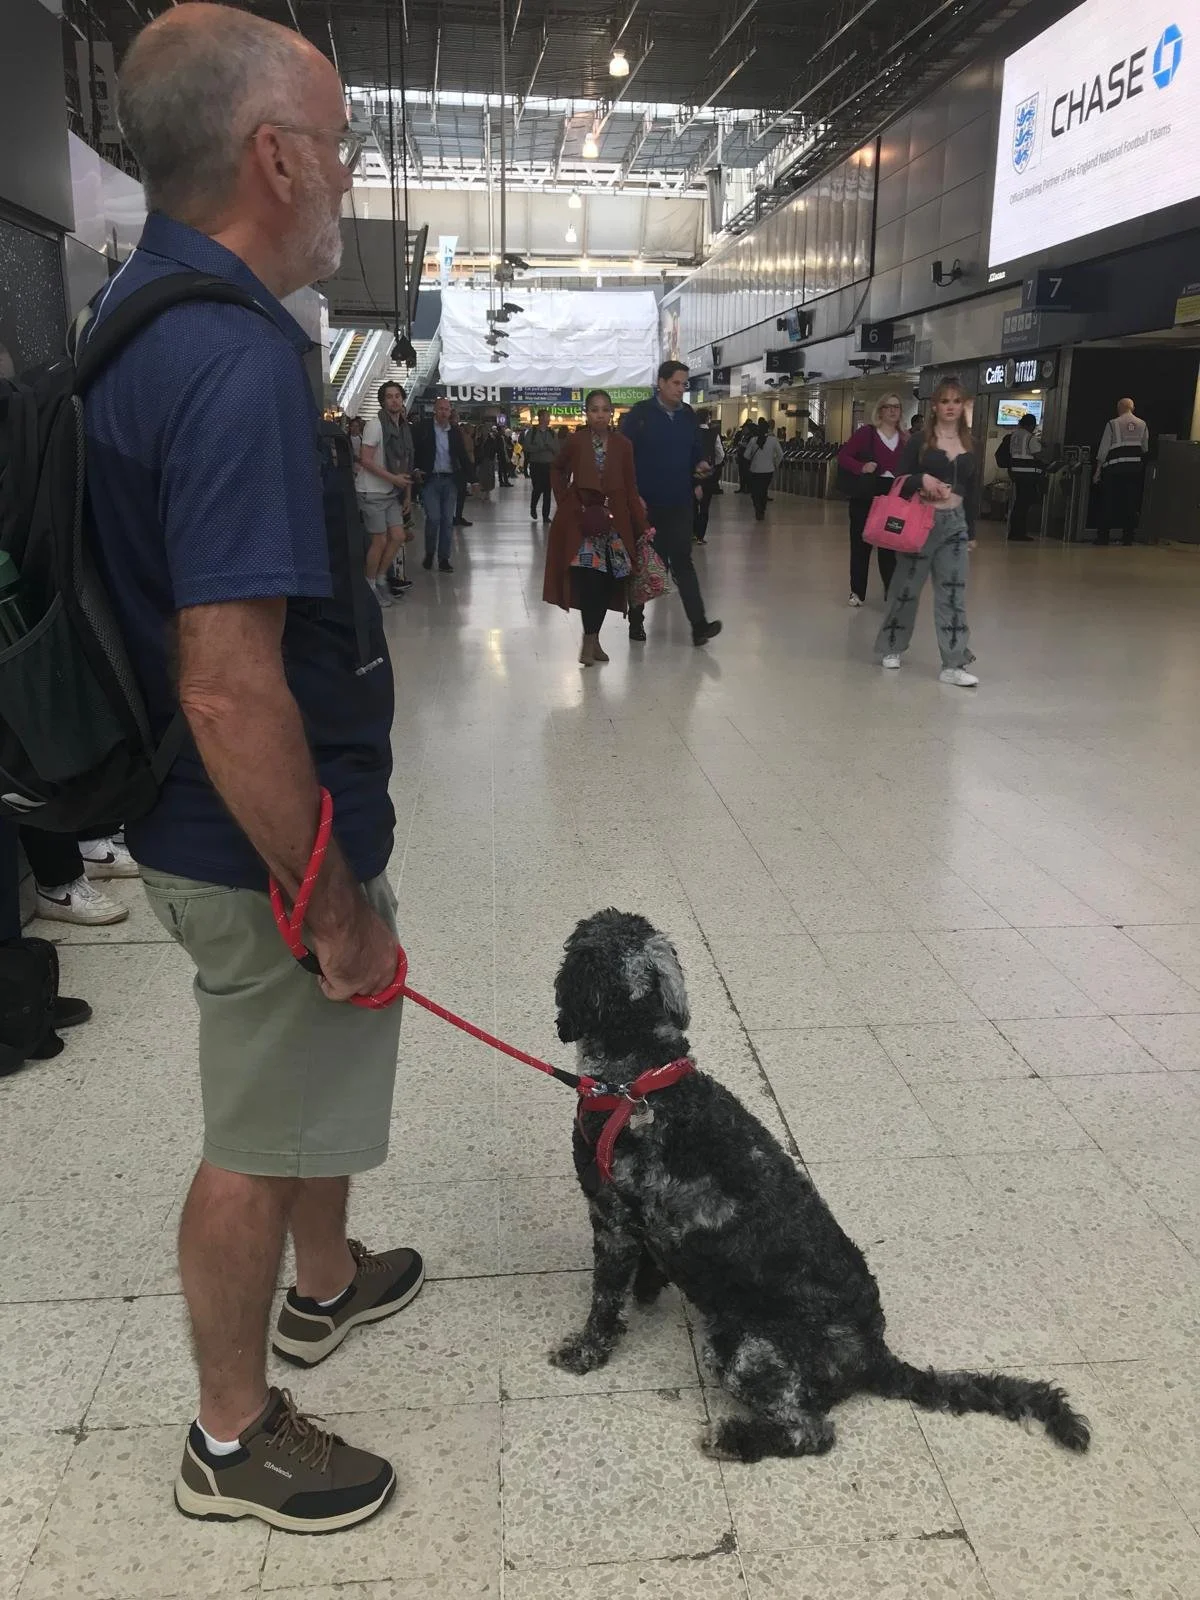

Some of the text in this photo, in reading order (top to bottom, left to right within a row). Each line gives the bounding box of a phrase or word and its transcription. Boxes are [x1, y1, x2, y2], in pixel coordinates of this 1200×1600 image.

[1051, 46, 1148, 138] CHASE
[1067, 166, 1077, 179] the
[1077, 154, 1099, 176] England
[1099, 142, 1124, 166] National
[1124, 131, 1149, 153] Football
[1150, 124, 1172, 141] Teams
[1049, 277, 1063, 298] 7
[868, 328, 879, 344] 6
[771, 356, 780, 367] 5
[717, 371, 724, 380] 4
[446, 384, 501, 401] LUSH
